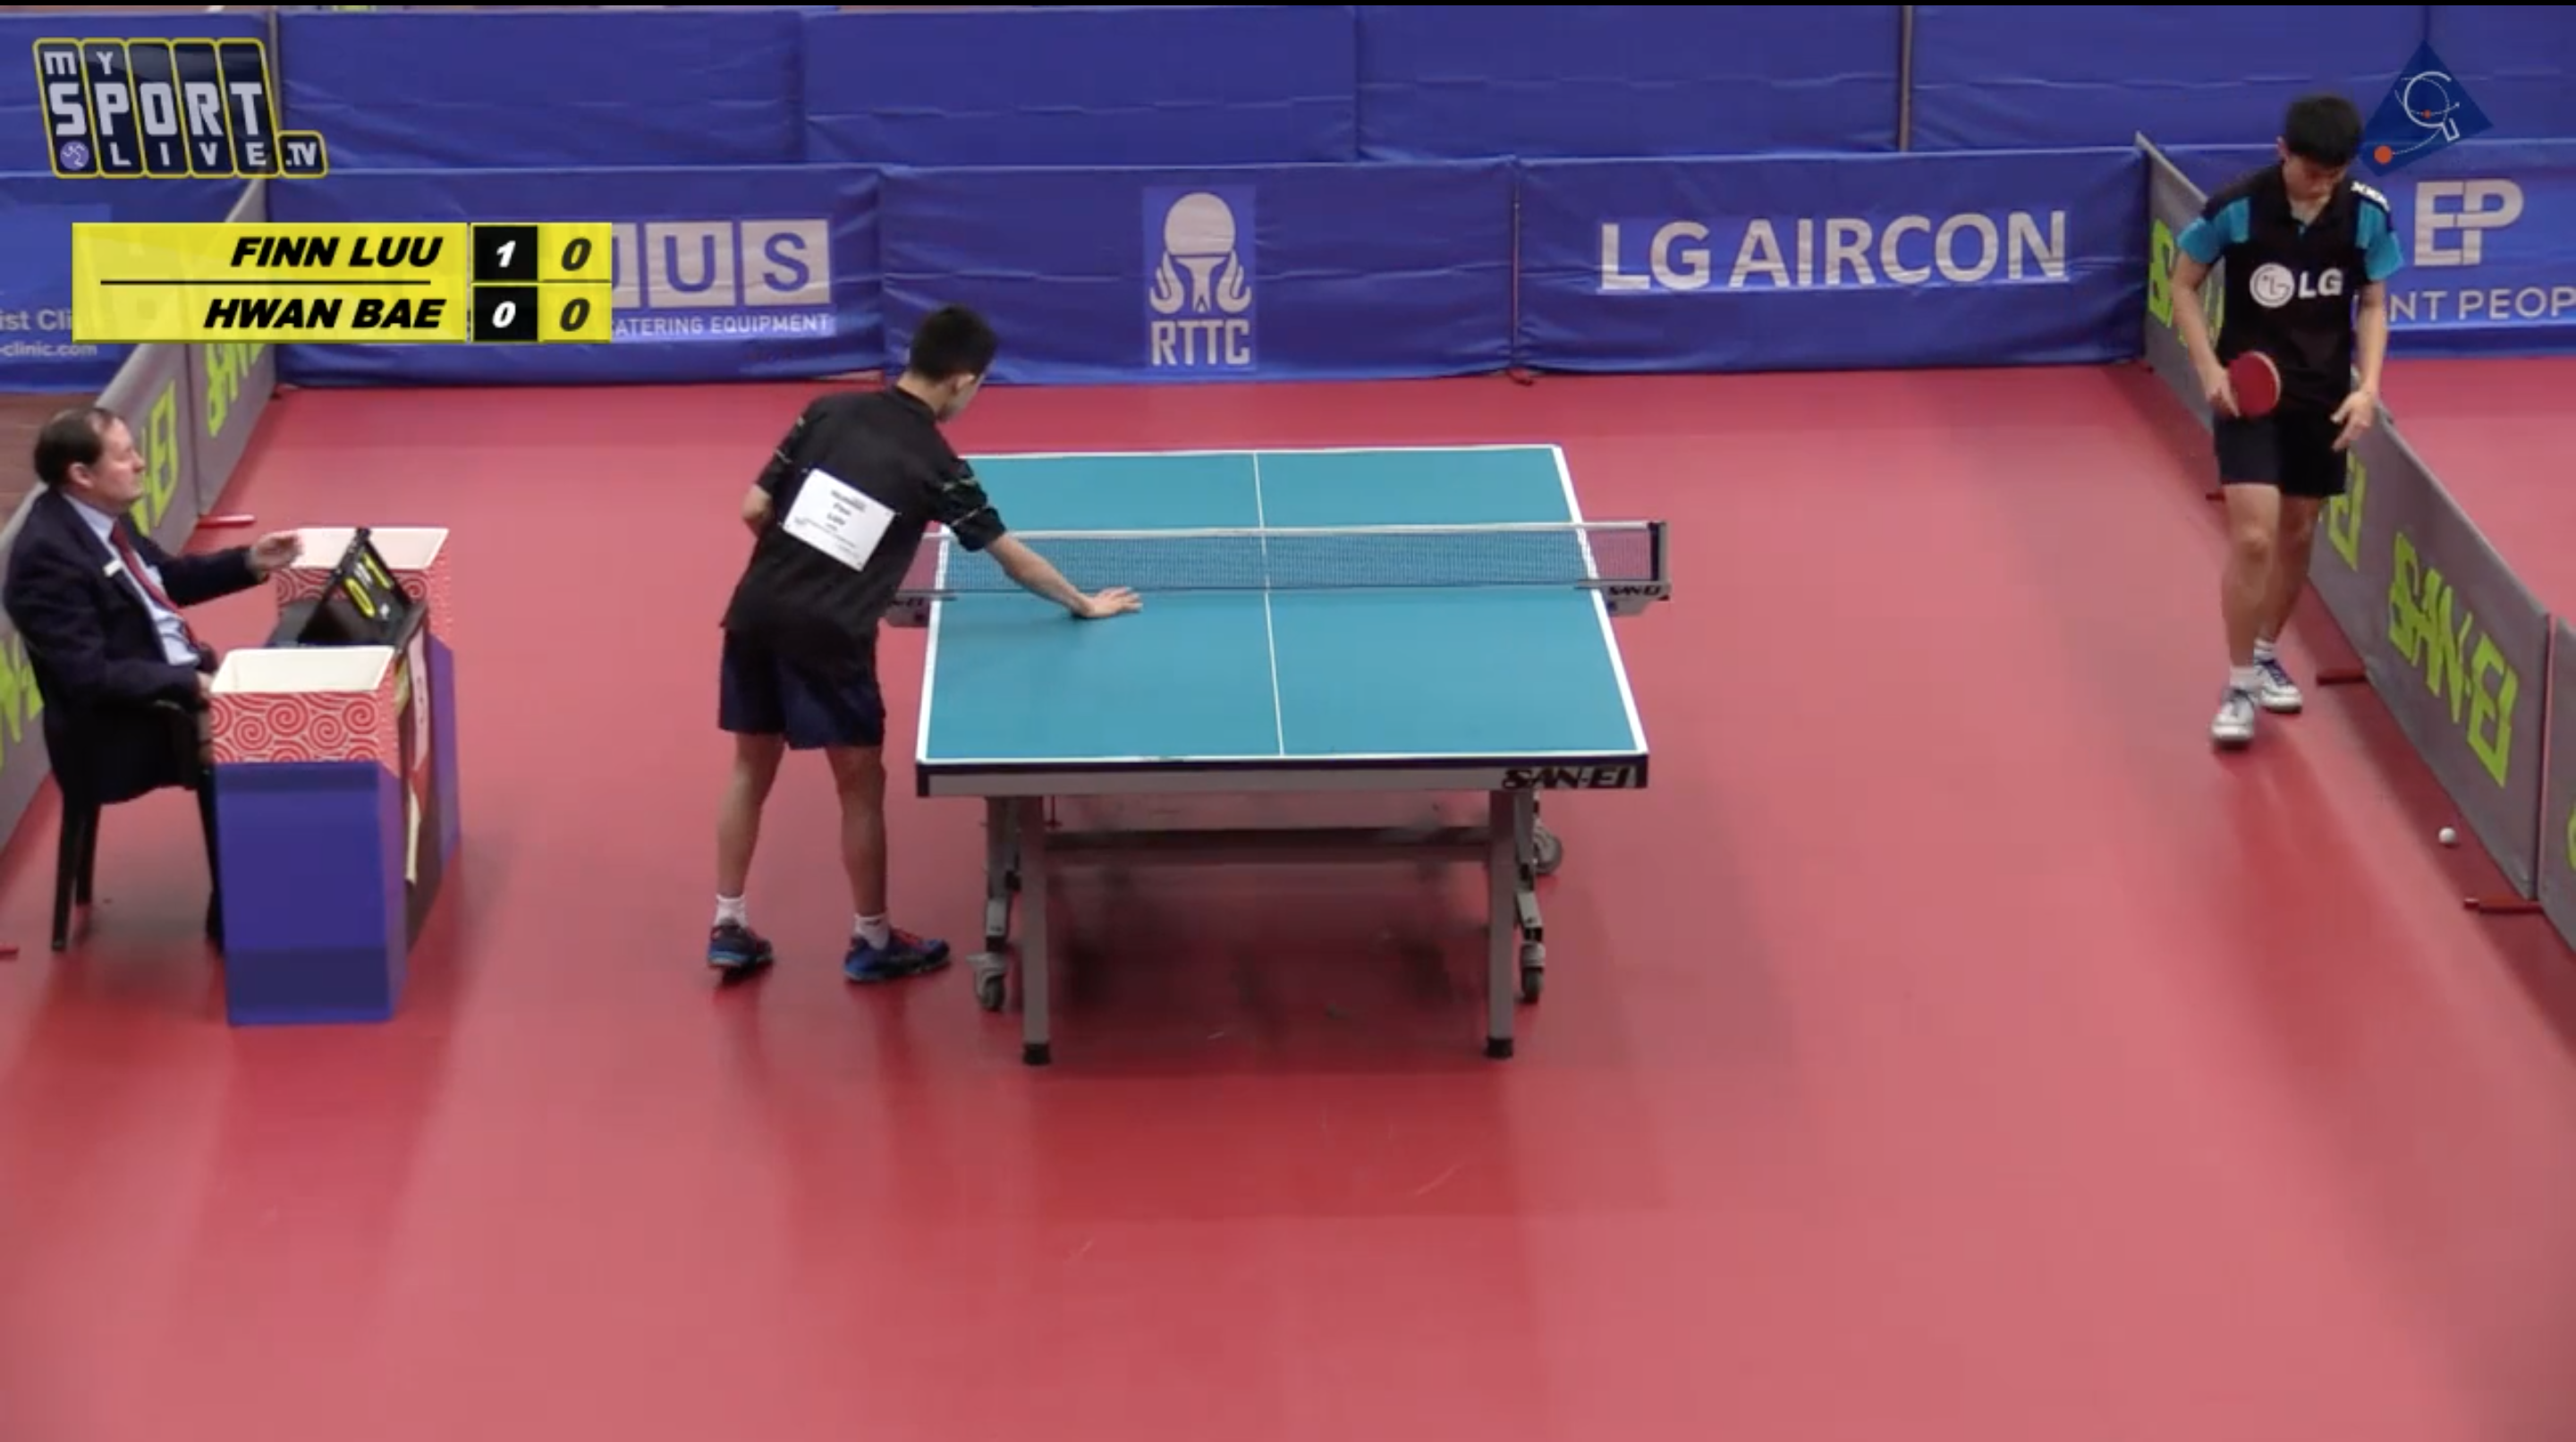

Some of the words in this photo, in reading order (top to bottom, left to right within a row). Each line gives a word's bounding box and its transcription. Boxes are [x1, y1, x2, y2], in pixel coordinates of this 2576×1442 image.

[2414, 179, 2524, 266] EP
[612, 233, 810, 293] US
[1601, 221, 1710, 291] LG
[1727, 210, 2066, 288] AIRCON
[2298, 267, 2343, 299] LG
[710, 313, 829, 334] EQUIPMENT
[1151, 319, 1250, 365] RTTC
